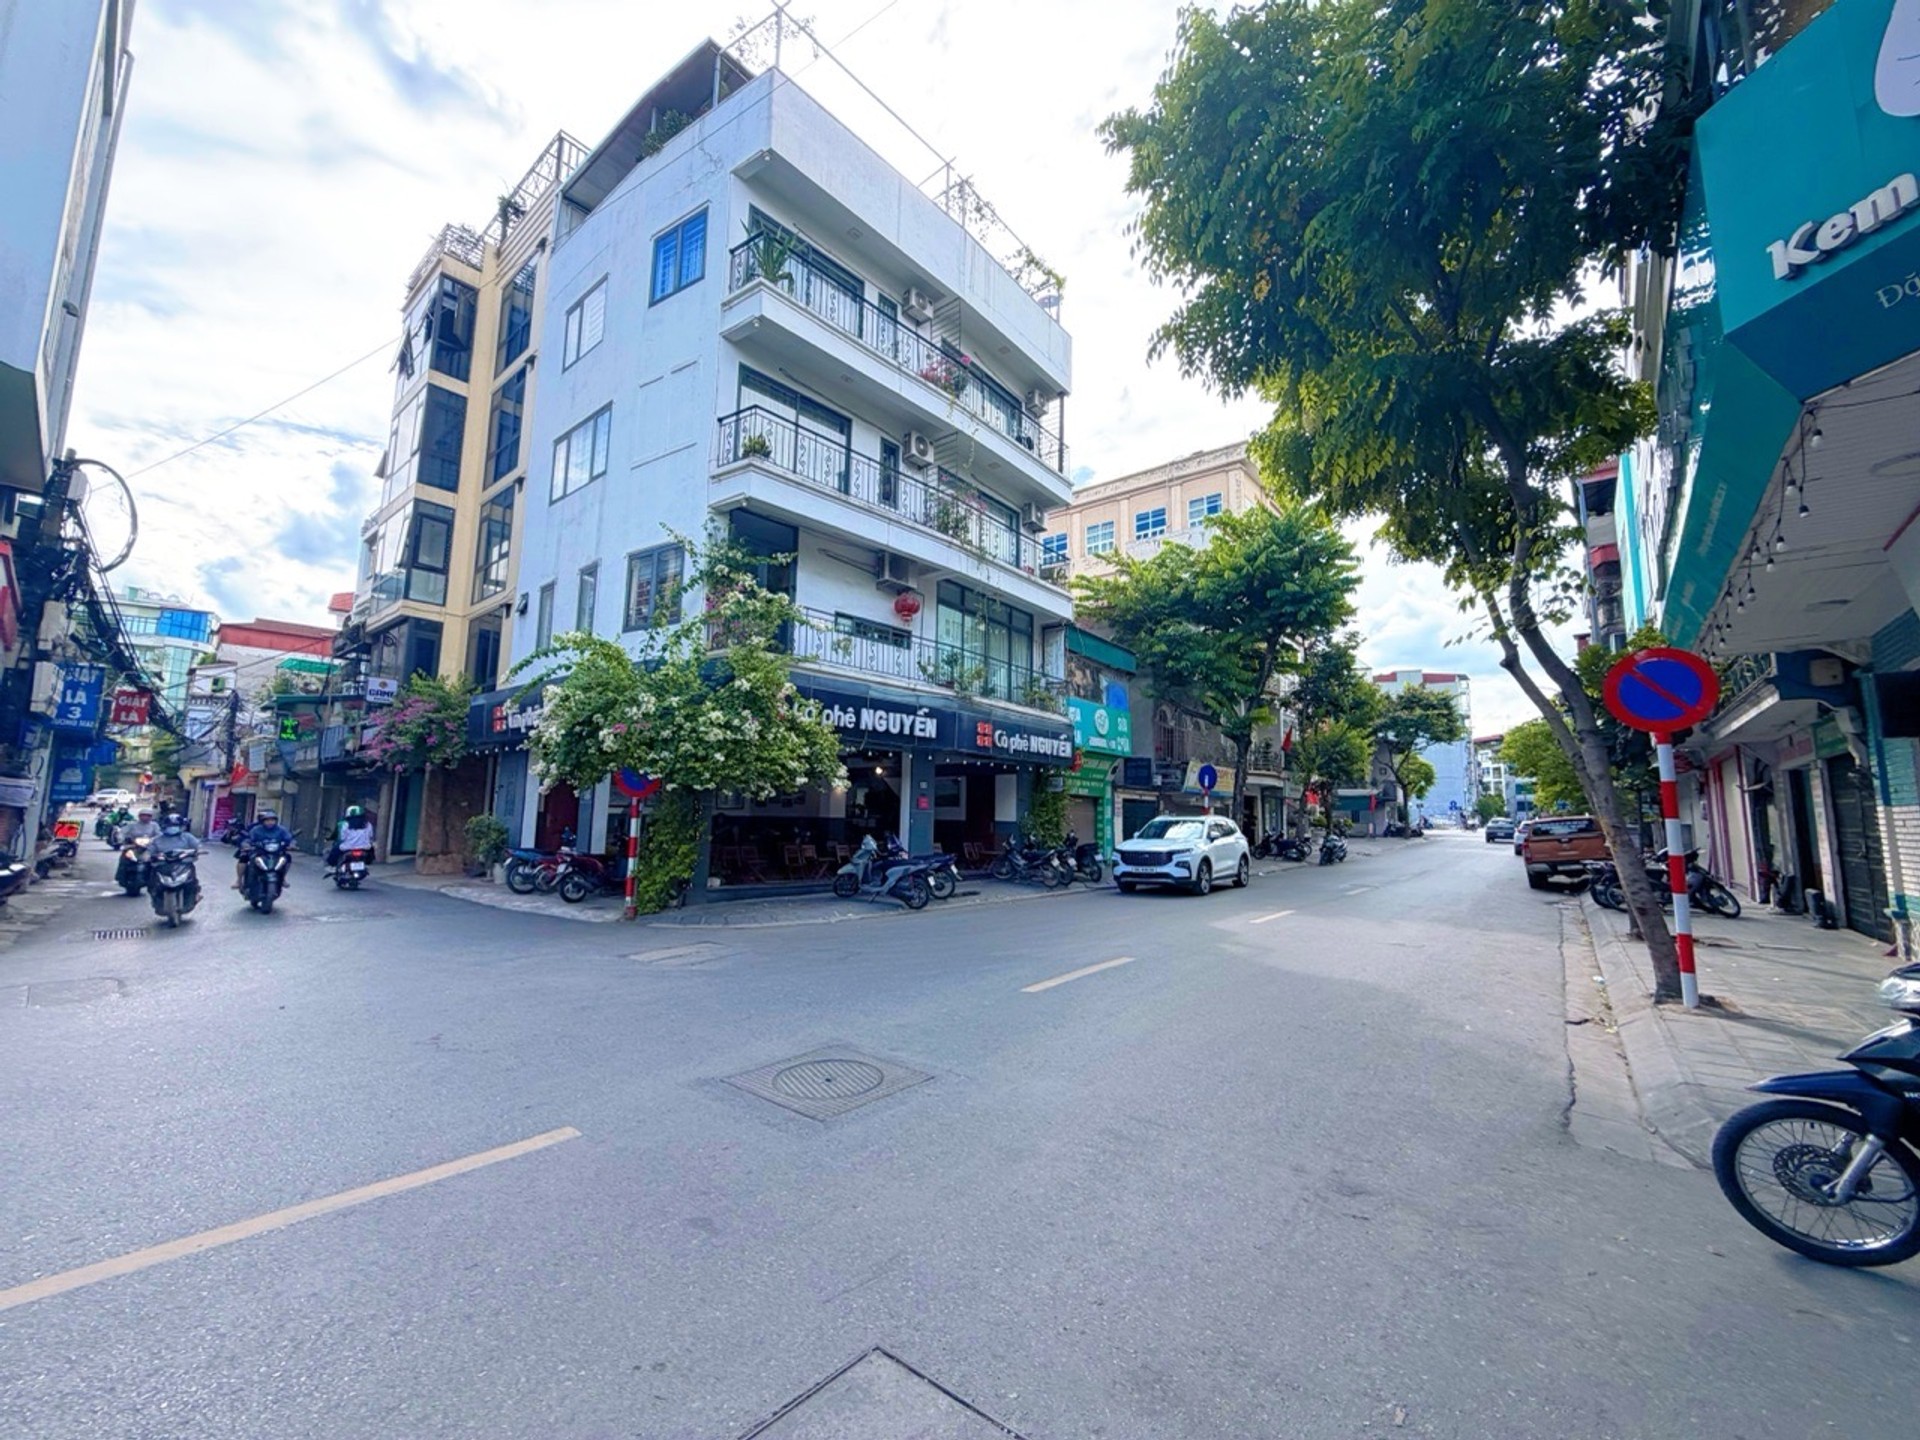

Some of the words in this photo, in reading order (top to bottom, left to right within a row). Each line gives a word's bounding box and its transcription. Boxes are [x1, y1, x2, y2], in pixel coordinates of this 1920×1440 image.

[1766, 172, 1919, 280] Kem
[67, 706, 82, 719] 3
[821, 704, 856, 730] phê
[859, 707, 937, 739] NGUYỄN
[994, 729, 1008, 748] Cà
[1009, 733, 1028, 754] phê
[1030, 734, 1072, 758] NGUYỄN
